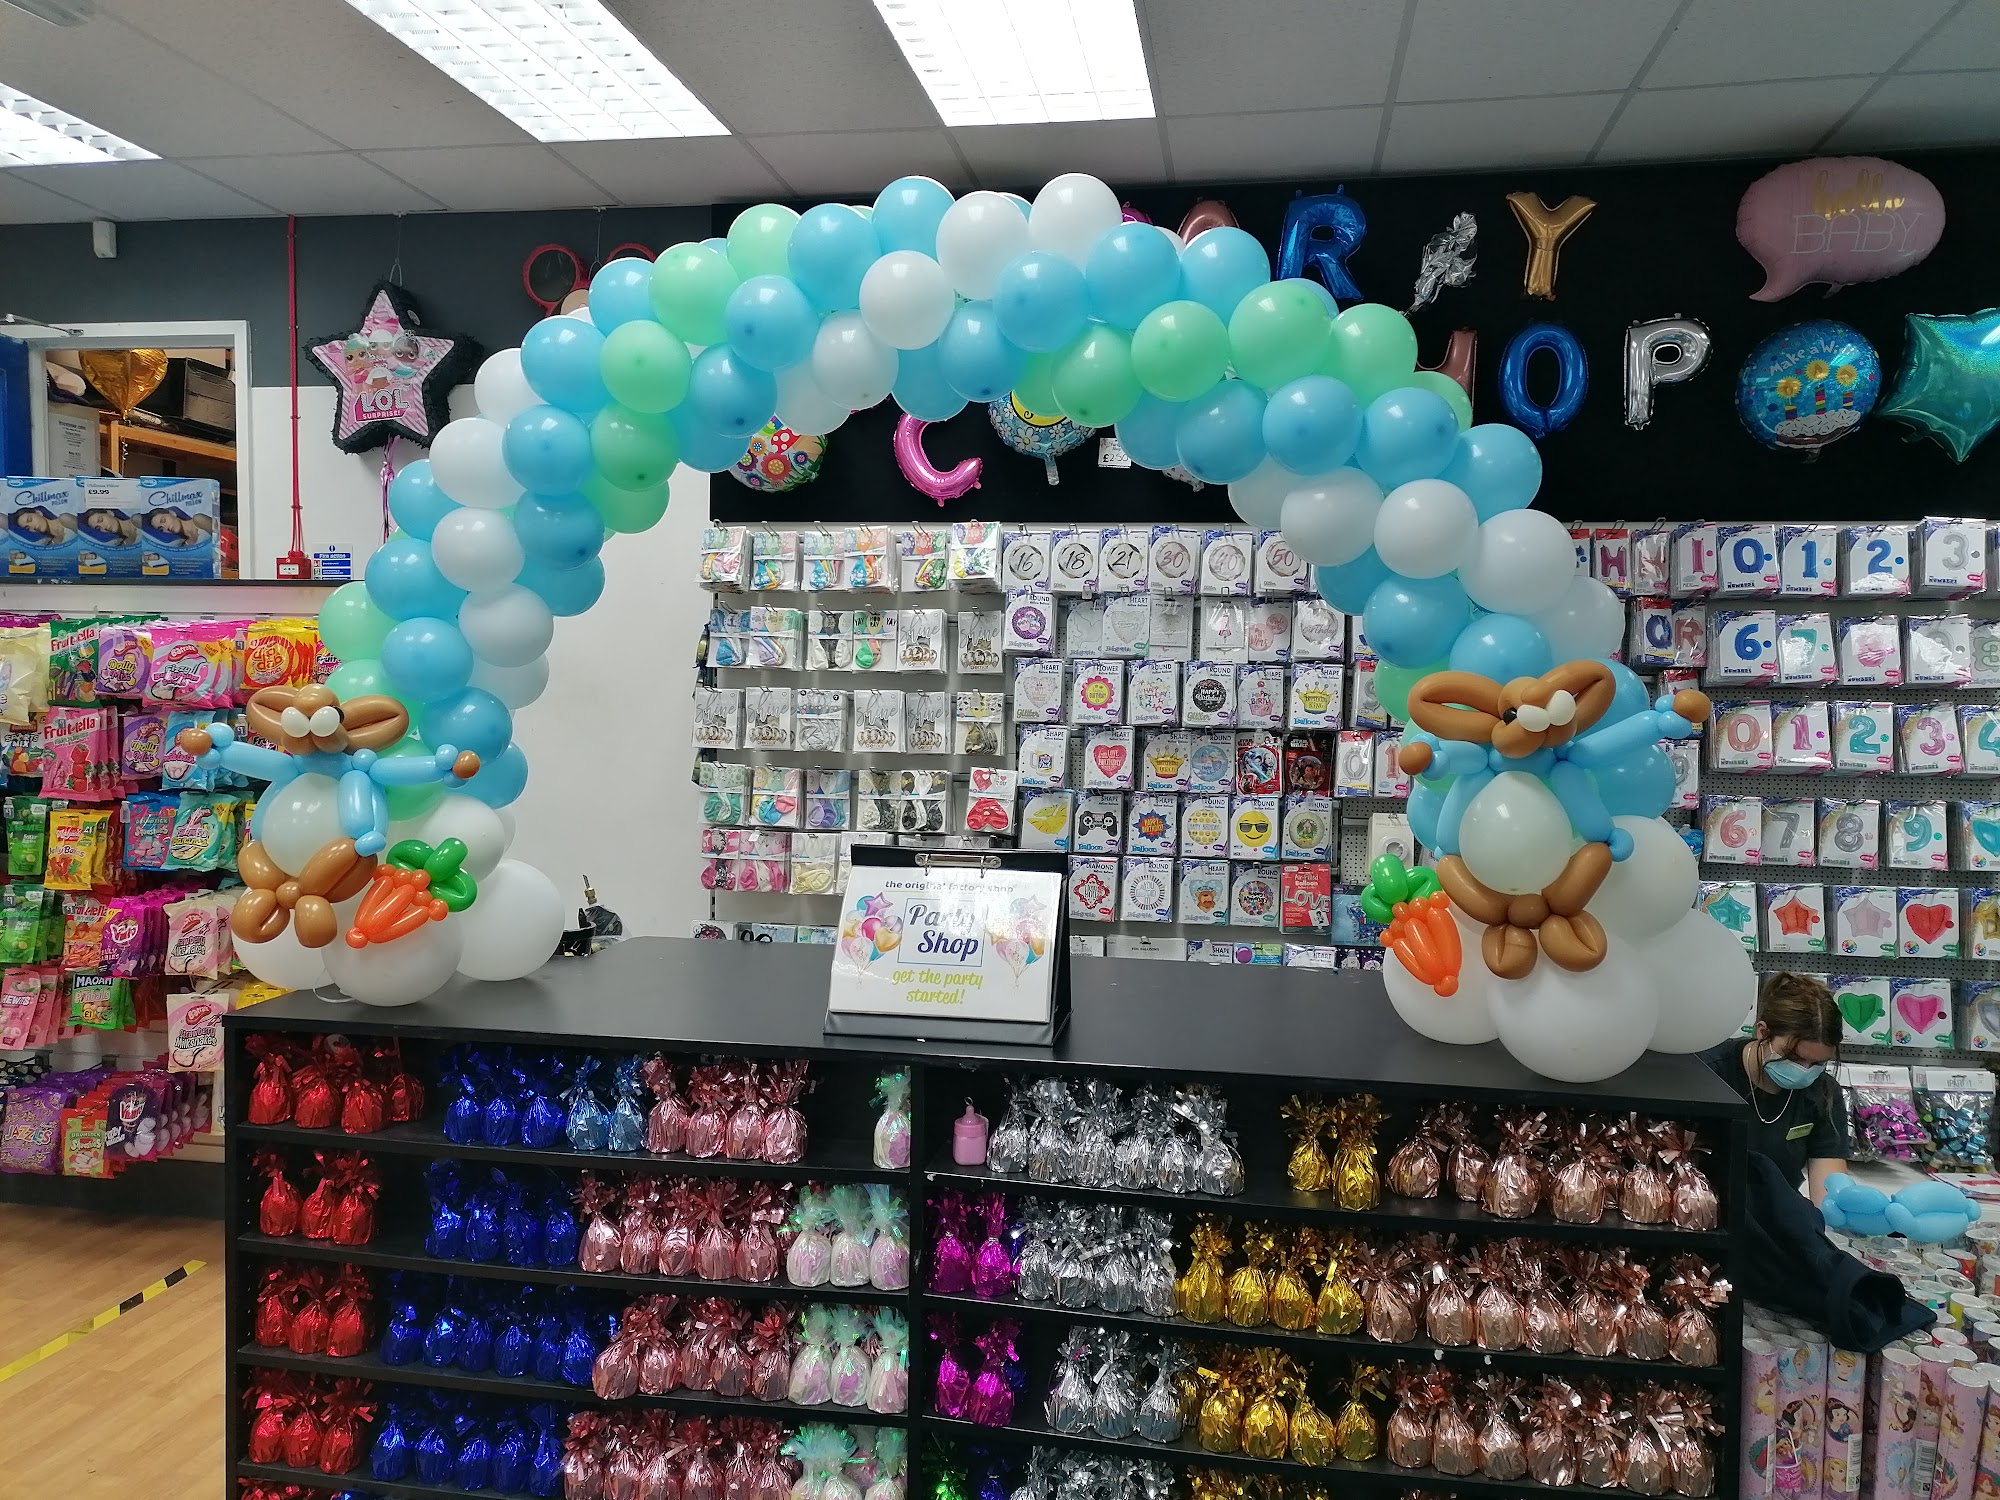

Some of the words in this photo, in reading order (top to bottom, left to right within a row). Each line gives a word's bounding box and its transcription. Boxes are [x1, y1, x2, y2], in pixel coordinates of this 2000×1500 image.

[1791, 211, 1924, 254] BABY
[1770, 348, 1805, 376] Make
[1809, 345, 1820, 359] a
[359, 388, 409, 412] LOL
[362, 409, 401, 420] SURPRISE!
[14, 490, 70, 507] Chillmax
[148, 490, 204, 507] Chillmax
[1016, 551, 1035, 572] 16
[1066, 550, 1086, 570] 18
[1112, 550, 1133, 570] 21
[1161, 550, 1185, 569] 30
[1273, 548, 1294, 567] 50
[1802, 540, 1818, 578] 1
[1867, 539, 1893, 575] 2
[1942, 531, 1969, 571] 3
[900, 613, 940, 645] shine
[960, 615, 1000, 649] shine
[1734, 623, 1762, 661] 6
[109, 659, 136, 676] Dolly
[256, 653, 284, 672] dab
[694, 693, 737, 724] shine
[747, 692, 790, 724] shine
[856, 694, 899, 728] shine
[909, 696, 944, 728] shine
[4, 732, 39, 743] SPORTS
[1790, 714, 1813, 750] 1
[1848, 715, 1881, 755] 2
[1916, 716, 1946, 756] 3
[130, 741, 159, 756] Dolly
[1720, 809, 1748, 849] 6
[1834, 813, 1864, 852] 8
[1903, 813, 1933, 852] 9
[1284, 885, 1330, 912] LOVE
[917, 929, 979, 962] Shop
[76, 976, 113, 987] MAOAM
[892, 969, 915, 986] get
[919, 968, 941, 984] the
[944, 972, 983, 990] party
[906, 988, 966, 1005] started!
[174, 1034, 217, 1050] Milkshakes
[179, 1026, 216, 1038] Strawberry
[6, 1125, 52, 1145] JAZZLES
